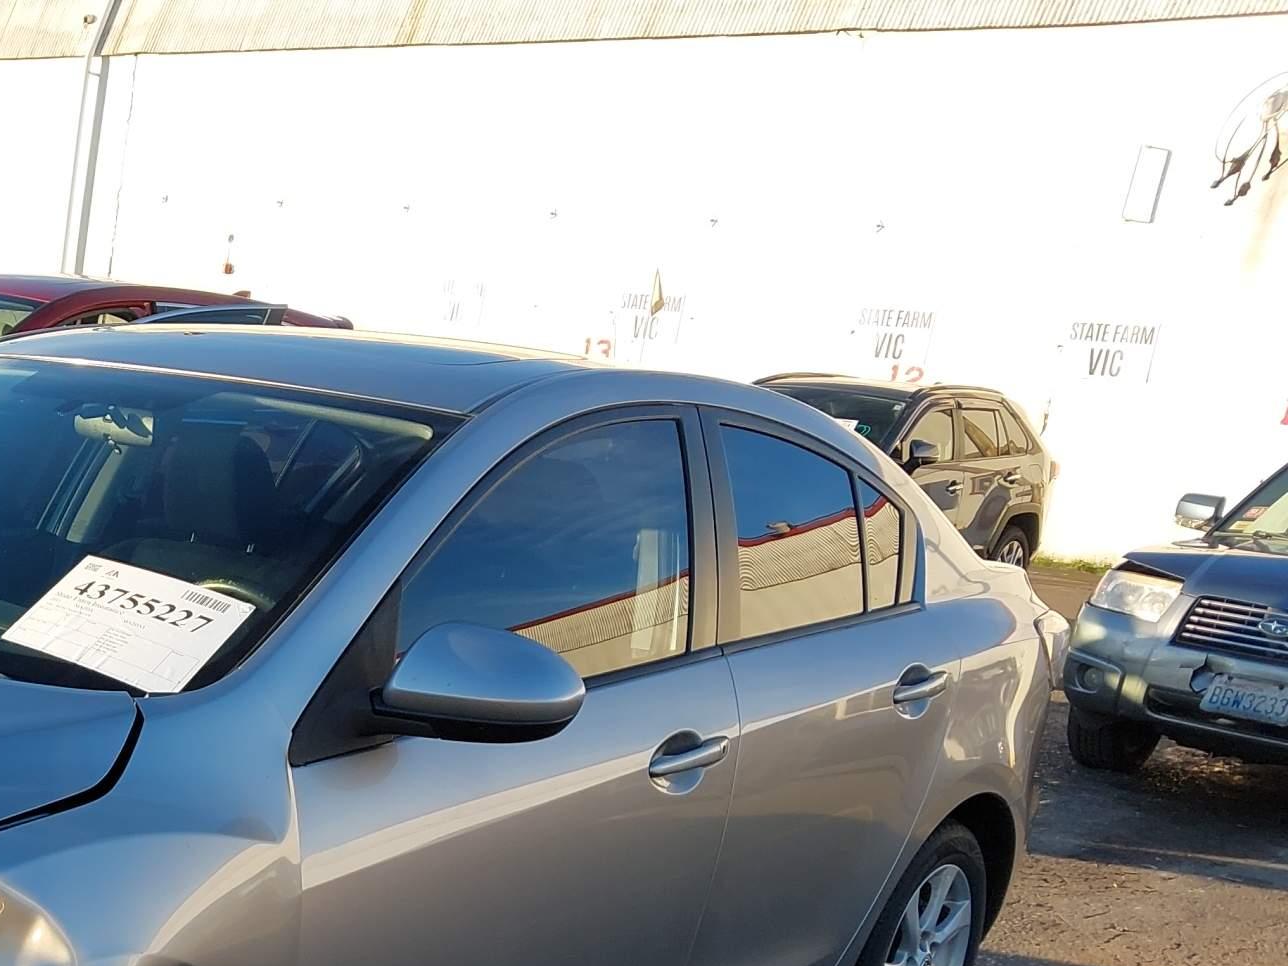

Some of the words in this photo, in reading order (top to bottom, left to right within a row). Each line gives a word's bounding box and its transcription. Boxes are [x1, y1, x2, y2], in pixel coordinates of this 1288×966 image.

[620, 293, 650, 311] STATE
[633, 315, 659, 340] VIC
[858, 308, 894, 328] STATE
[895, 310, 934, 329] FARM
[874, 332, 905, 360] VIC
[1070, 322, 1111, 342] STATE
[1112, 324, 1155, 345] FARM
[1089, 347, 1124, 377] VIC
[73, 580, 215, 633] 43755227
